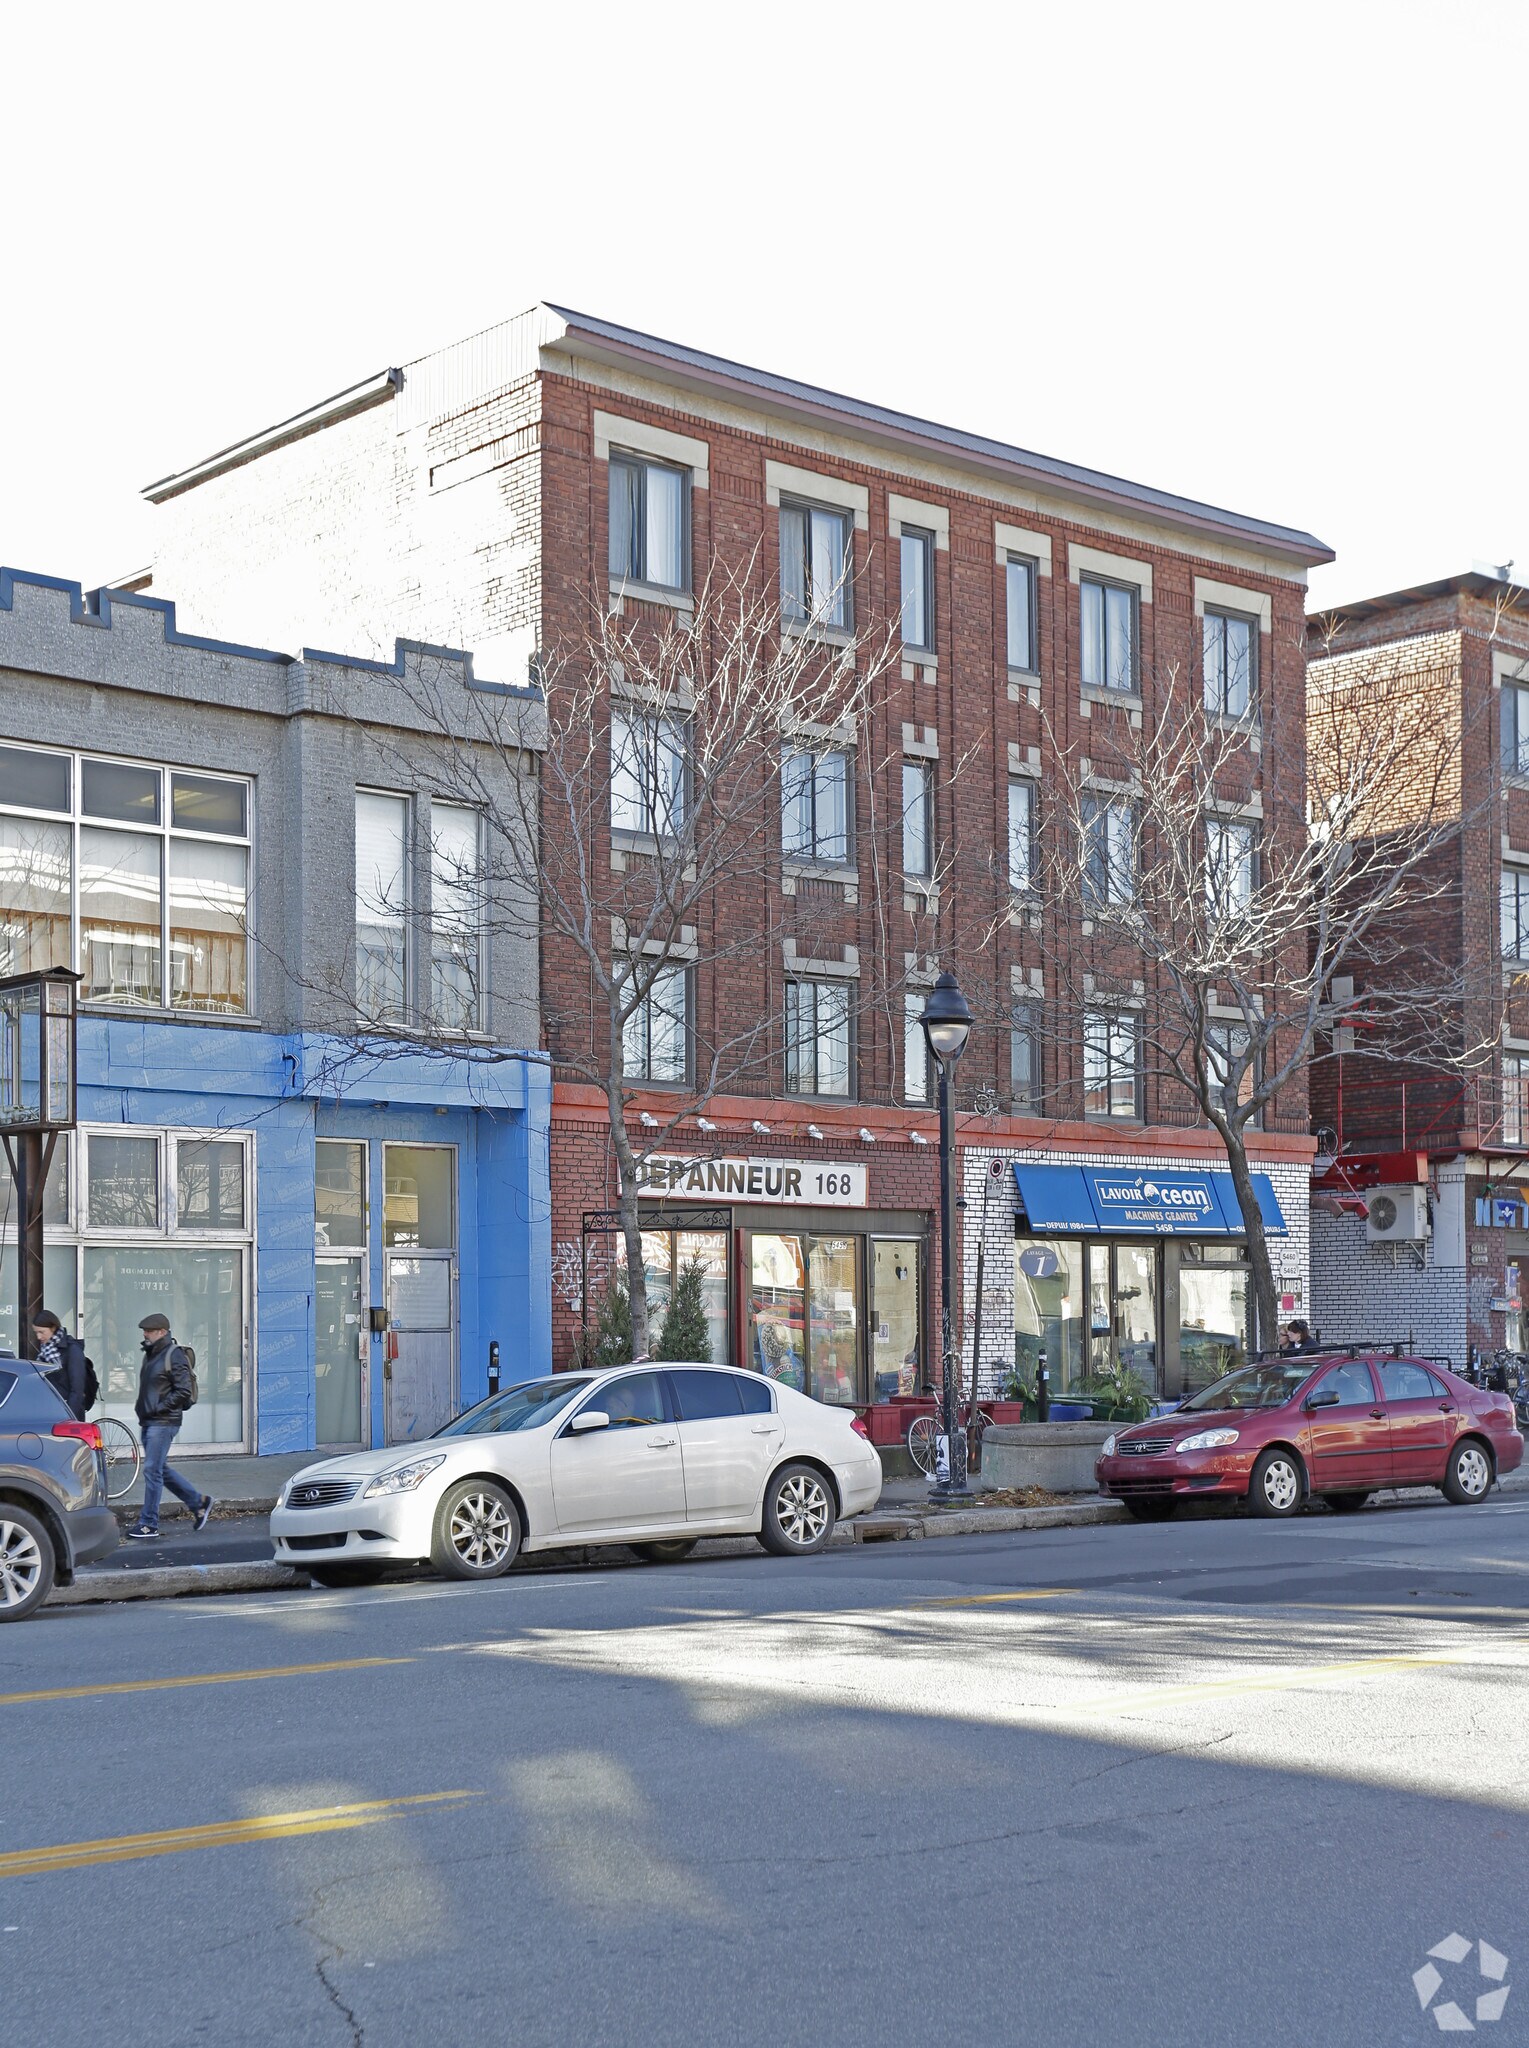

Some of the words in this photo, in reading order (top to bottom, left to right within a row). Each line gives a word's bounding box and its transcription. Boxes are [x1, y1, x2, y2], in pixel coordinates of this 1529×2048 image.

[815, 1173, 851, 1196] 168
[1100, 1187, 1145, 1202] LAVOIR
[1125, 1210, 1164, 1222] MACHINES
[1164, 1212, 1199, 1223] GEANTES
[1045, 1222, 1068, 1230] DEPUIS
[1069, 1222, 1085, 1230] 1984
[1155, 1223, 1174, 1233] 5458
[1282, 1253, 1296, 1261] 5460
[1283, 1279, 1302, 1293] LOUER
